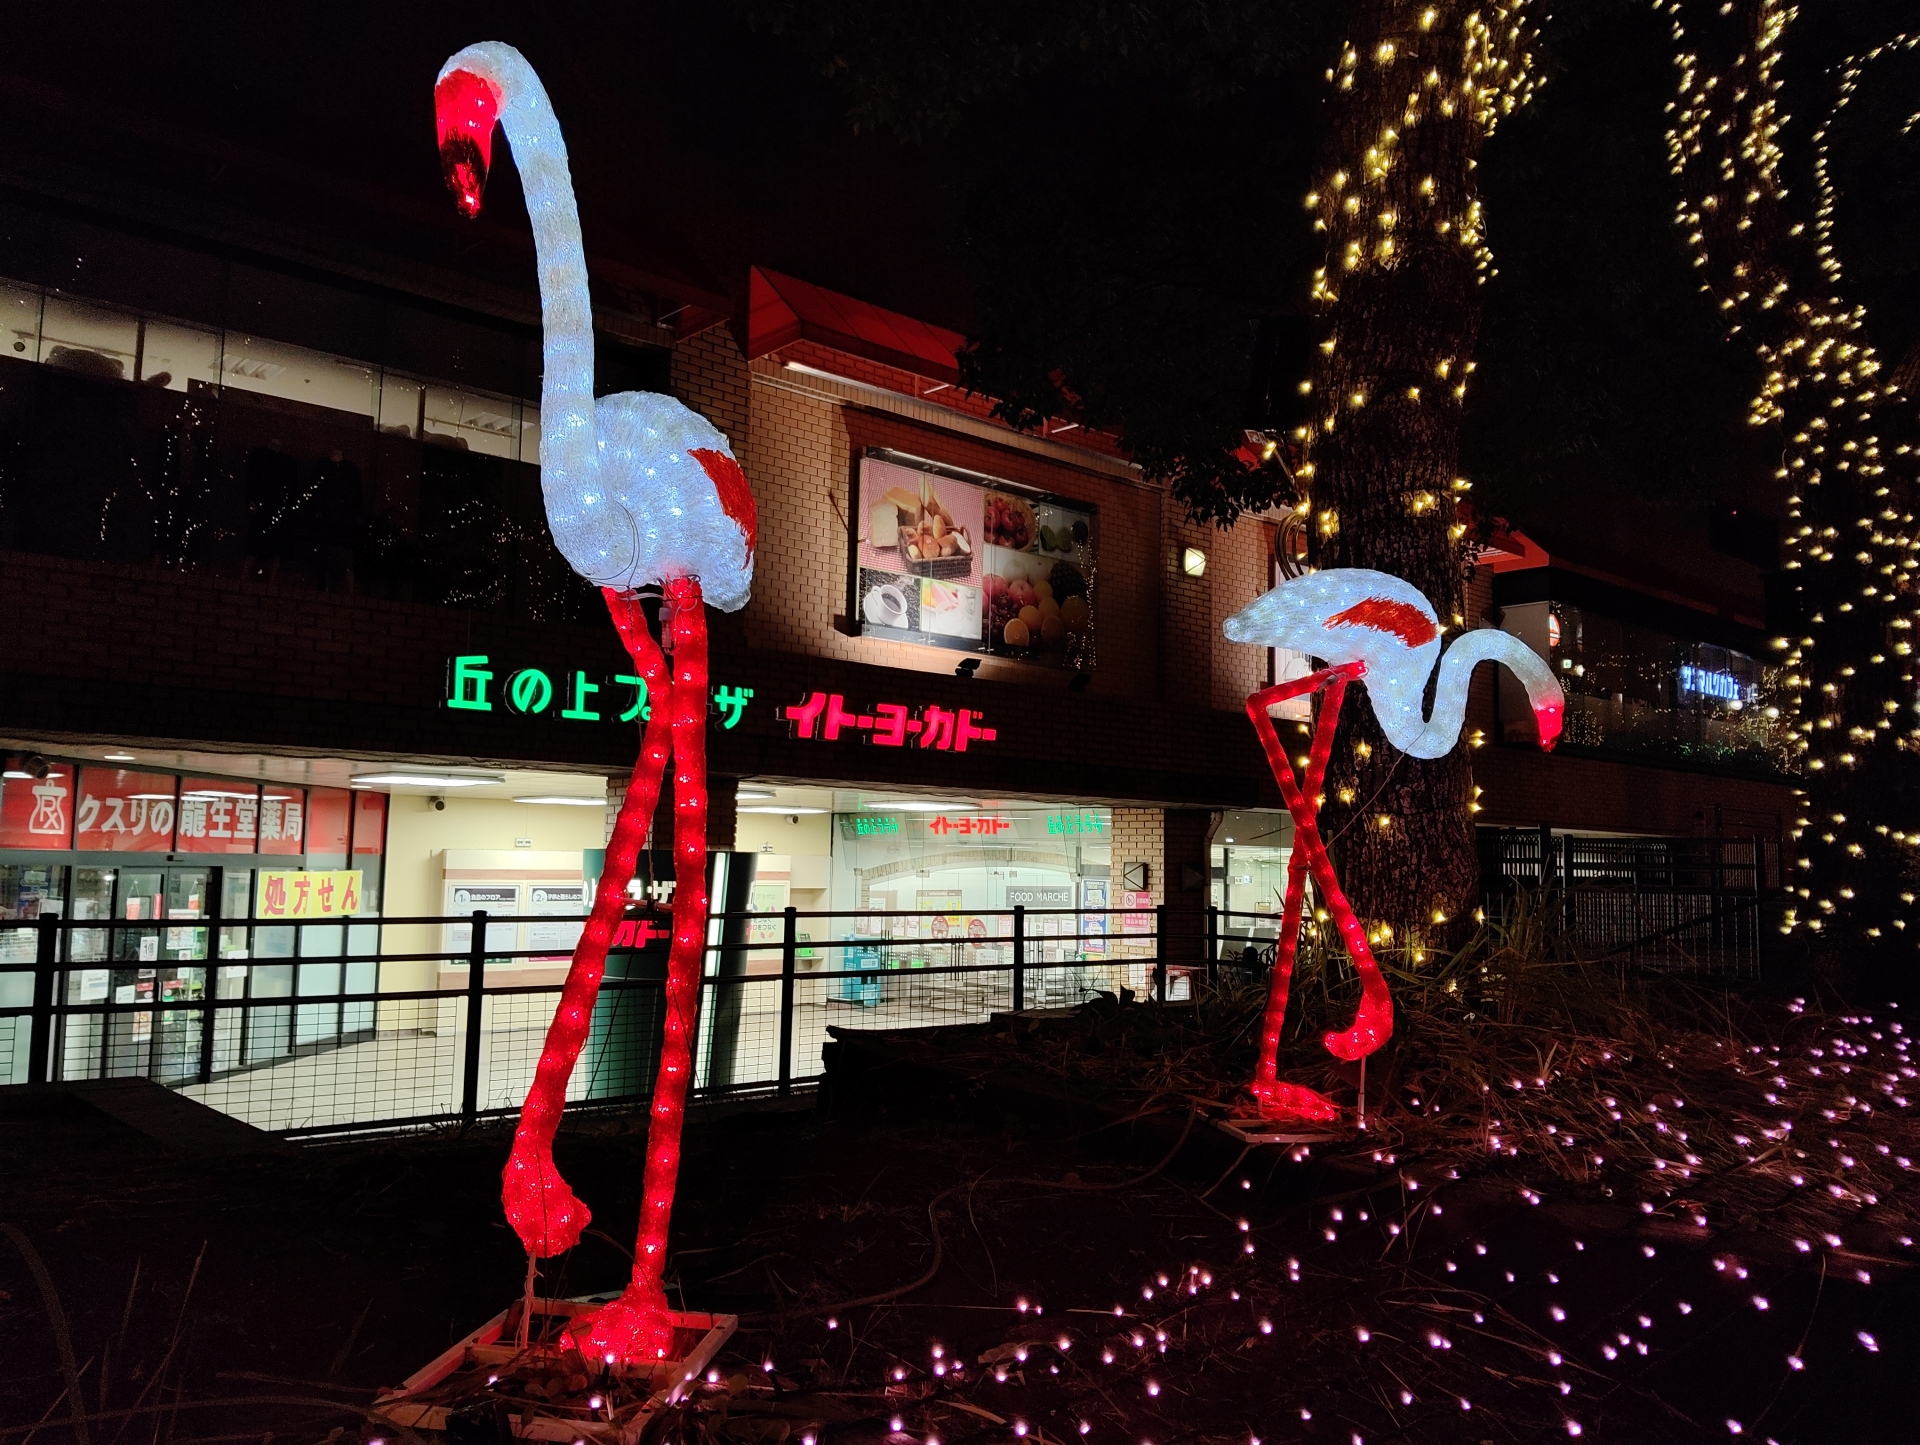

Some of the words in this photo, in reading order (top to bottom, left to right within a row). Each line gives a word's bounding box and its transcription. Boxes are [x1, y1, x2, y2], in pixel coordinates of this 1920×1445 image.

[448, 655, 754, 730] 丘の上プザ
[786, 691, 998, 752] イトーヨーカドー
[77, 793, 303, 842] クスリの龍生堂薬局
[929, 815, 1010, 835] イトーヨーカドー
[263, 875, 358, 916] 処方せん
[1010, 892, 1034, 902] FOOD
[1036, 892, 1069, 902] MARCHE
